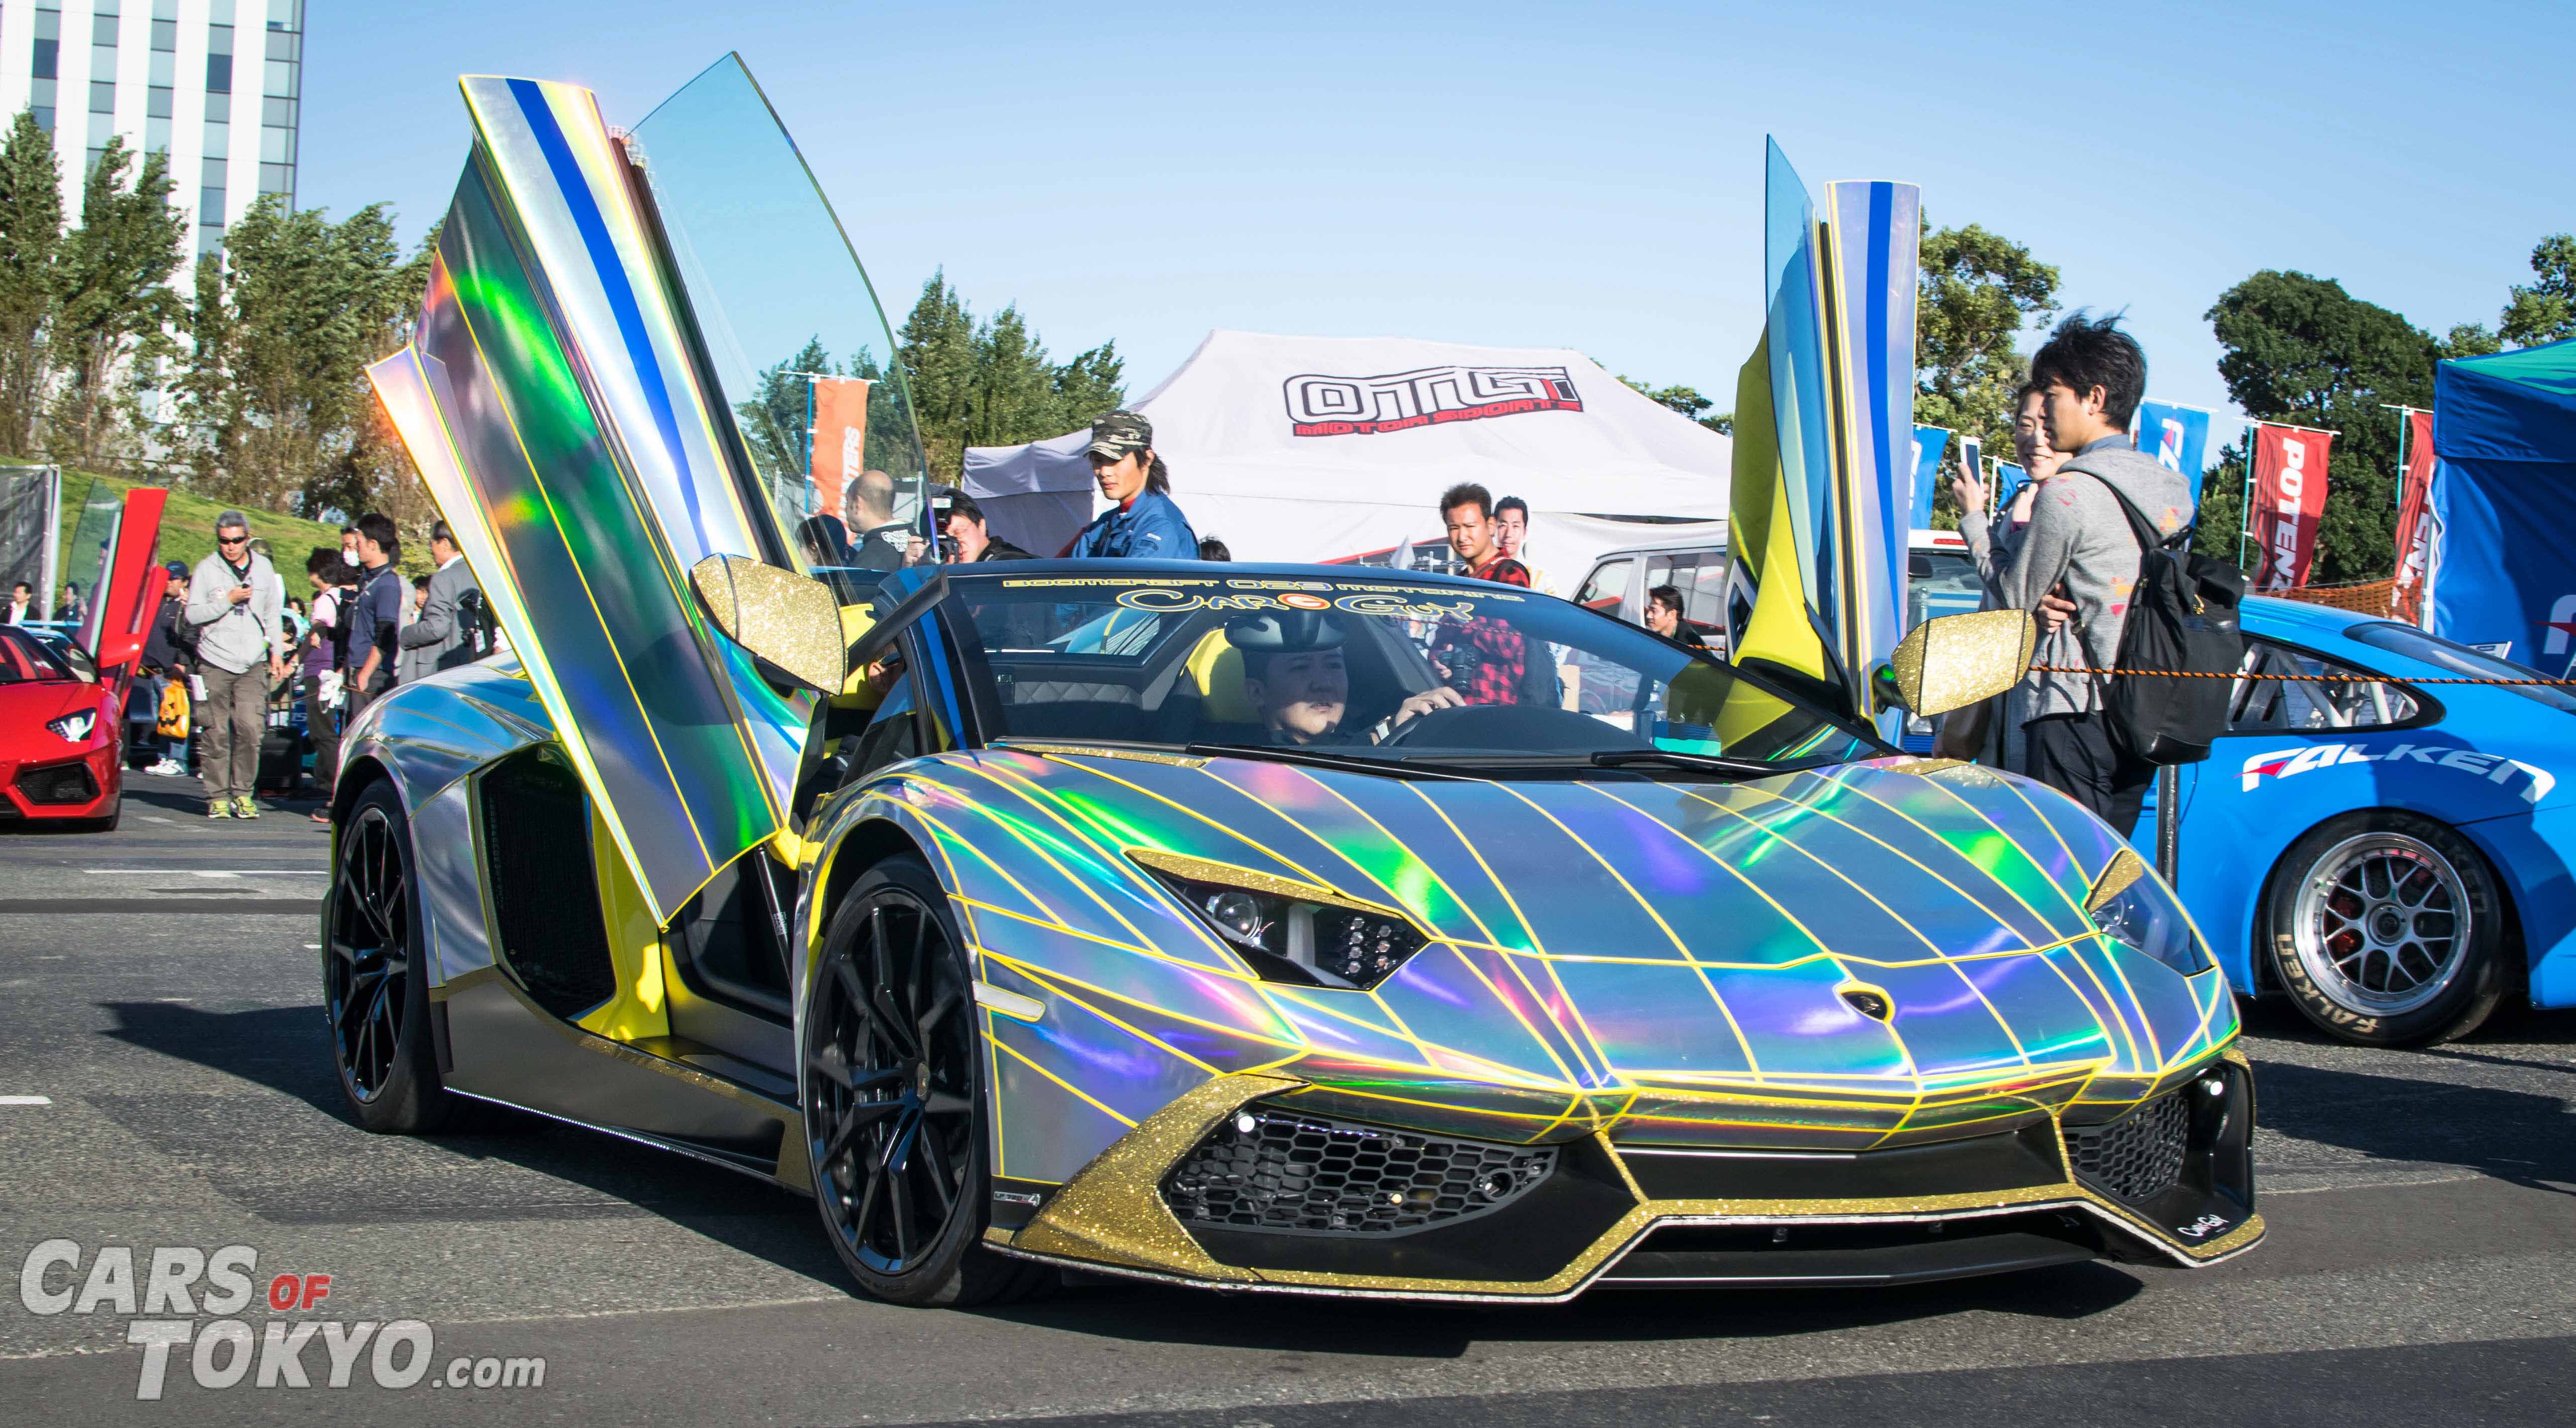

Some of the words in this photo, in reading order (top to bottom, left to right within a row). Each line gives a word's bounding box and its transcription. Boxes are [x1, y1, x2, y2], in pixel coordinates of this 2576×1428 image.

[1294, 414, 1429, 436] MOTOR
[1431, 399, 1583, 425] SPORTS
[2233, 744, 2556, 804] FALKEN
[2276, 934, 2380, 1033] FALKEN
